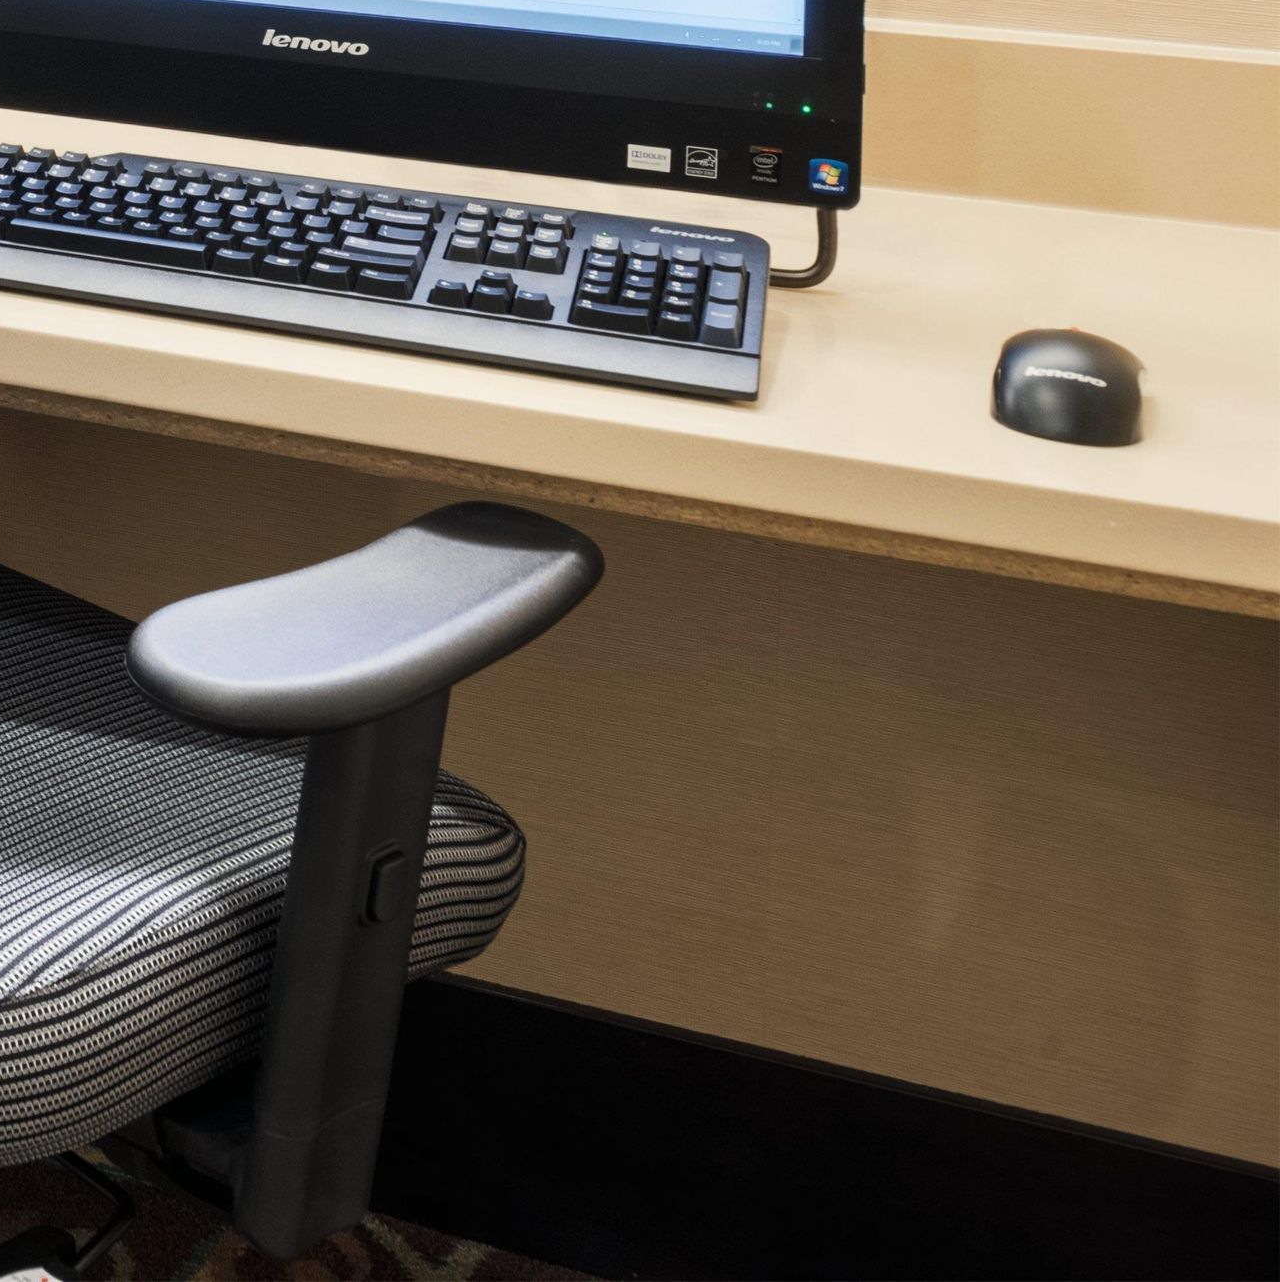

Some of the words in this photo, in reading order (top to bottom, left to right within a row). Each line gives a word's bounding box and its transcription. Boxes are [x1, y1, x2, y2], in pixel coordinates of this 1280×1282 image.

[262, 29, 369, 56] lenovo
[756, 155, 777, 165] intel
[812, 182, 840, 192] Windows
[650, 226, 735, 243] lenovo
[1023, 366, 1107, 388] lenovo
